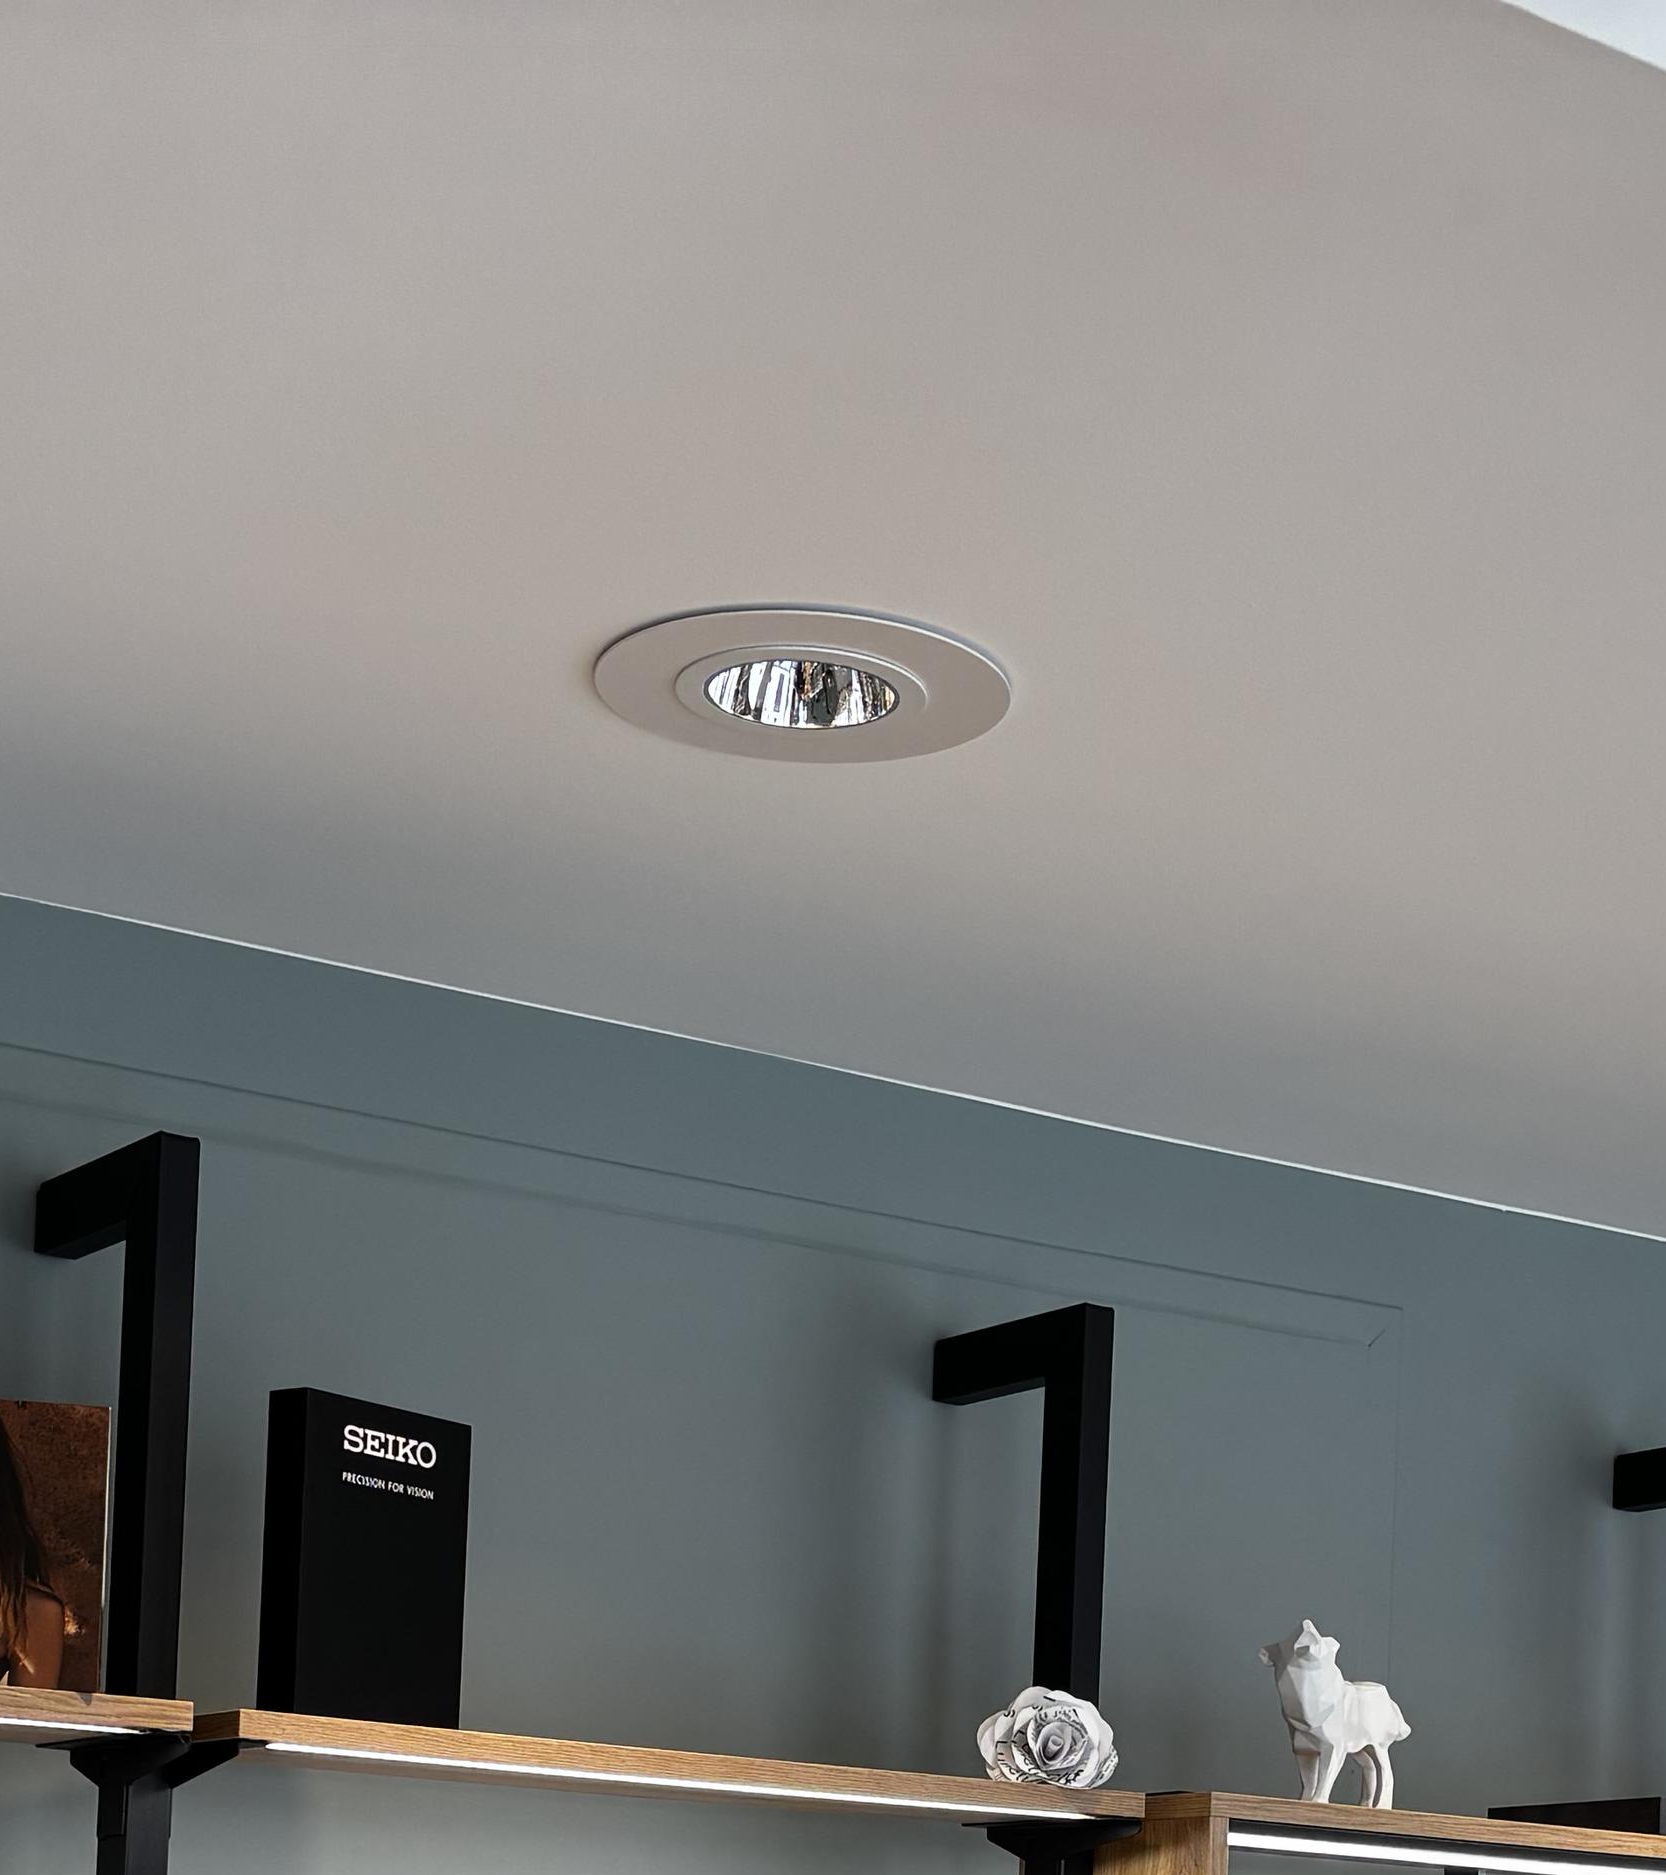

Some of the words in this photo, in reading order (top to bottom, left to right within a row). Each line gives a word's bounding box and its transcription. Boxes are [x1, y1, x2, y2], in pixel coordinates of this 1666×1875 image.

[343, 1424, 437, 1469] SEIKO
[342, 1471, 385, 1490] PRECISION
[388, 1481, 404, 1494] FOR
[407, 1486, 434, 1500] VISION
